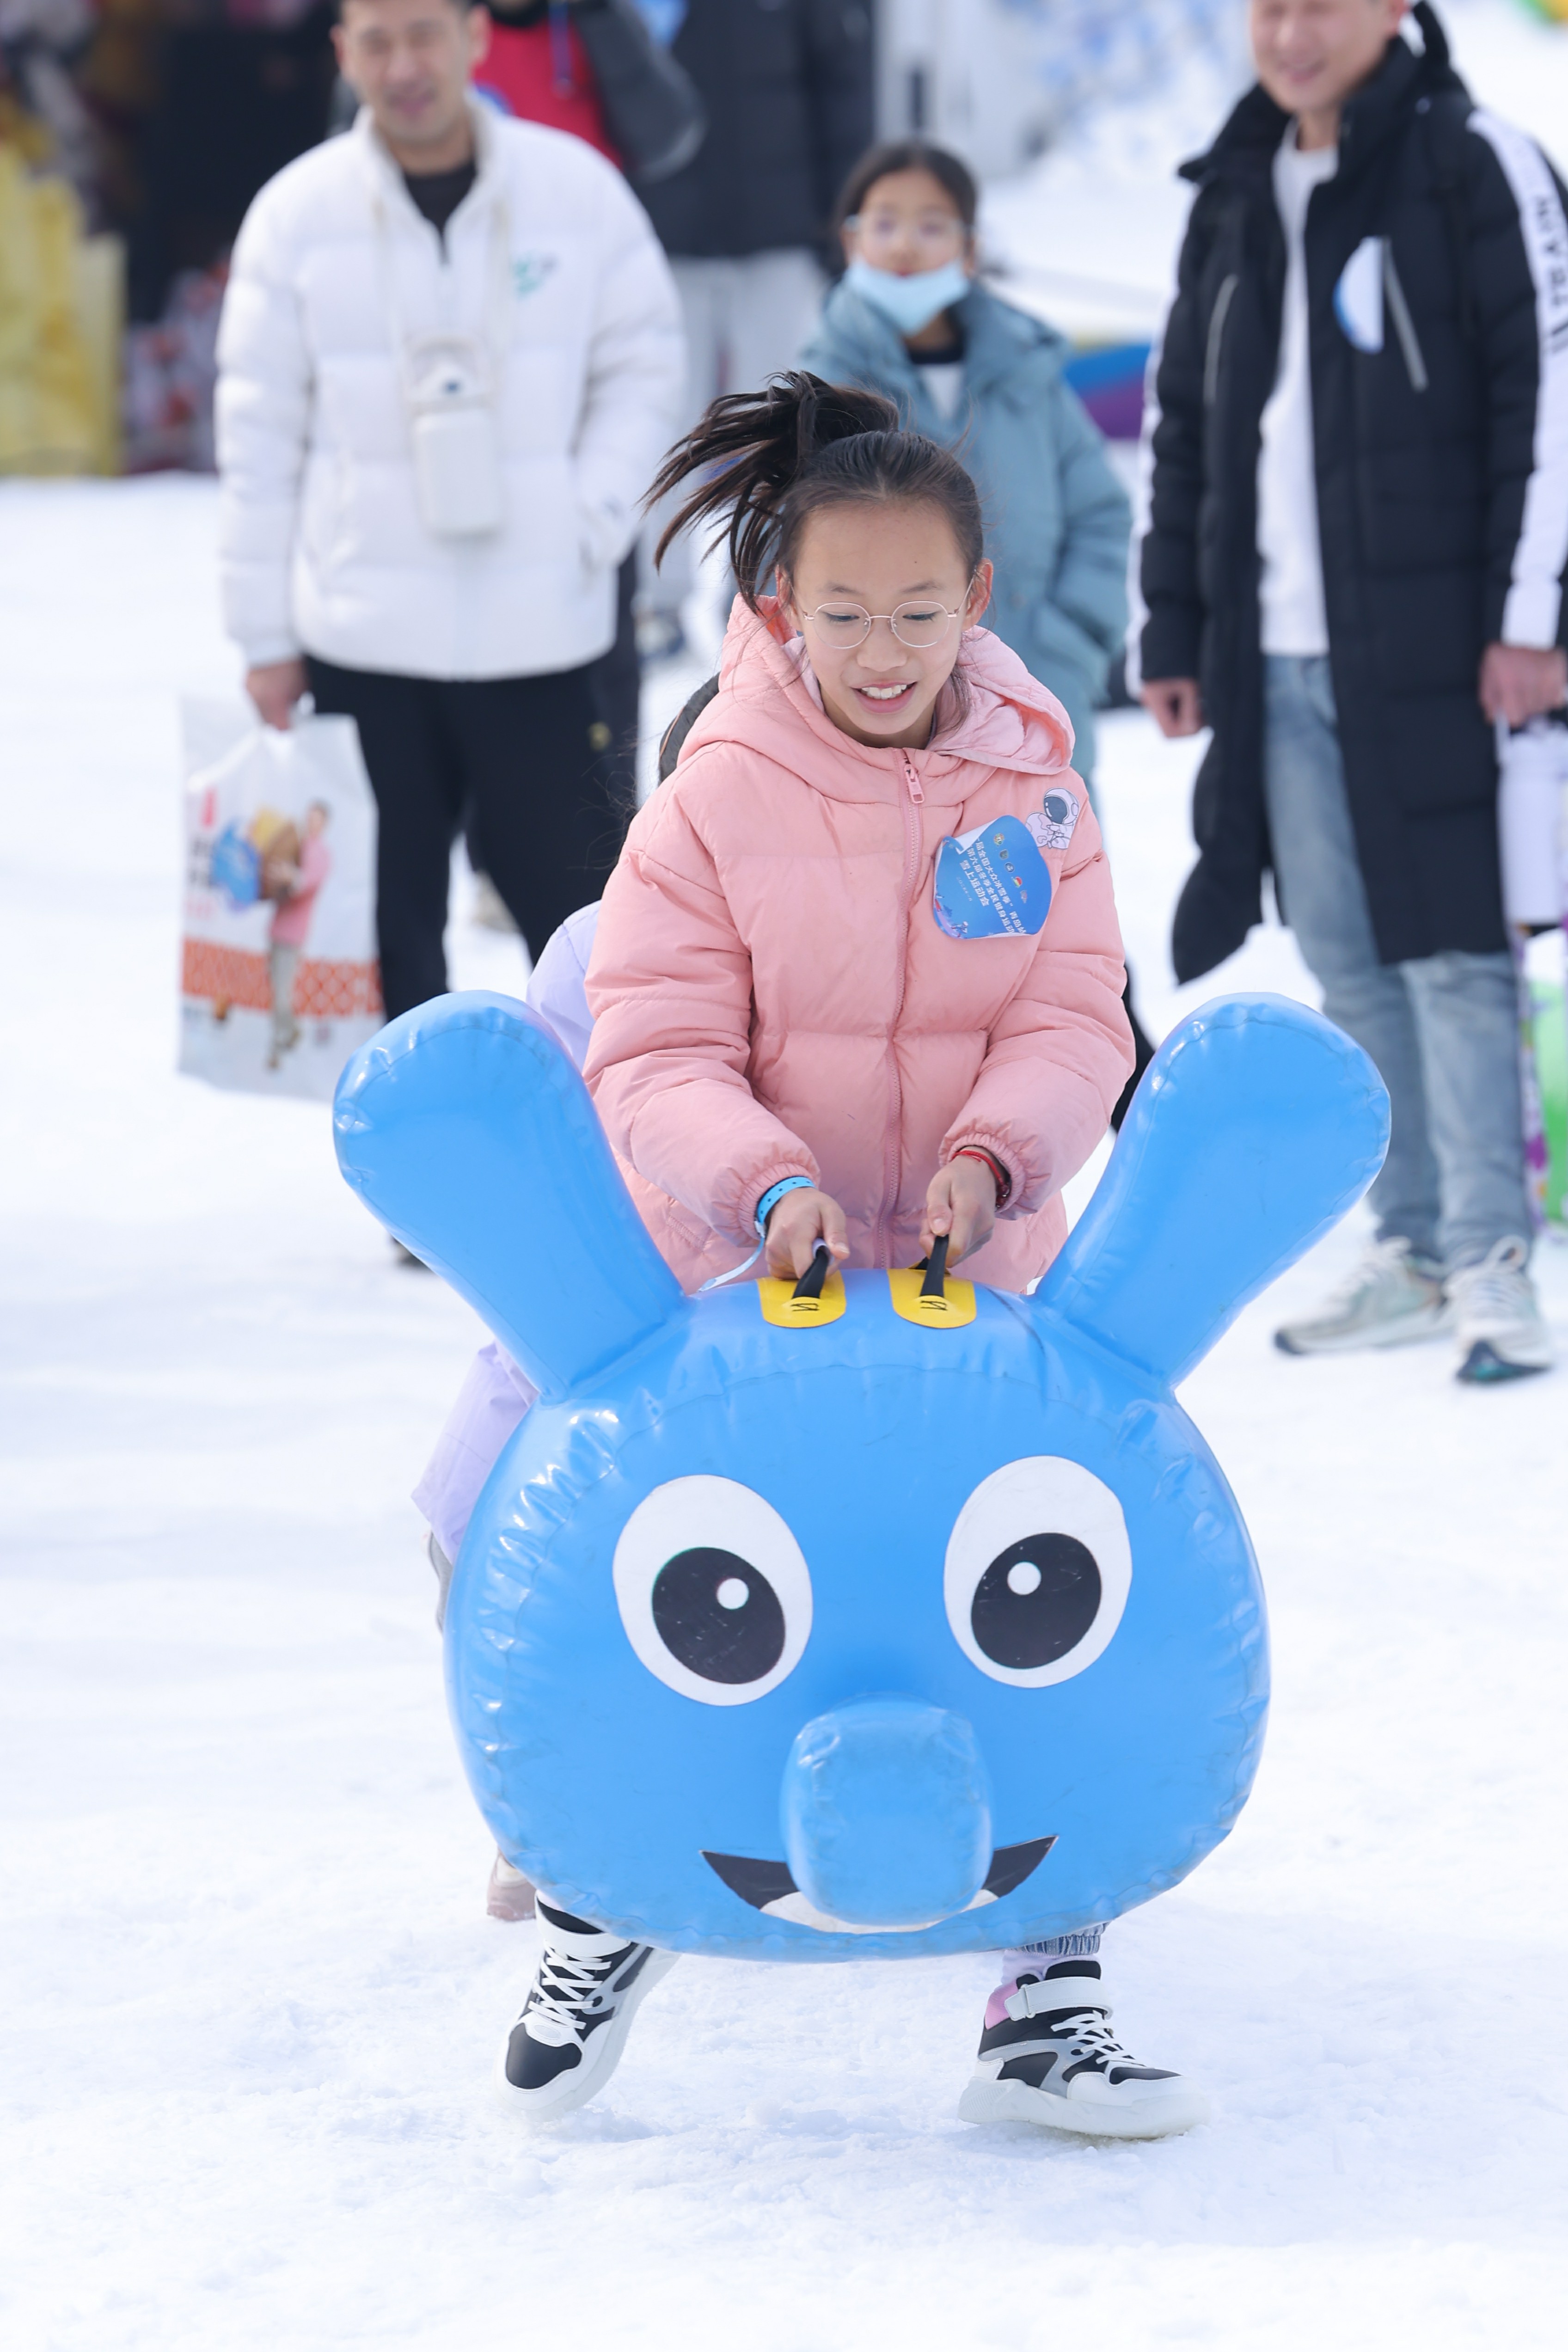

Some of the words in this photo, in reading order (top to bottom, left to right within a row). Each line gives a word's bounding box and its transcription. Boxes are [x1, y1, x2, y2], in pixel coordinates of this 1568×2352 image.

[960, 860, 989, 906] 雪上运动会
